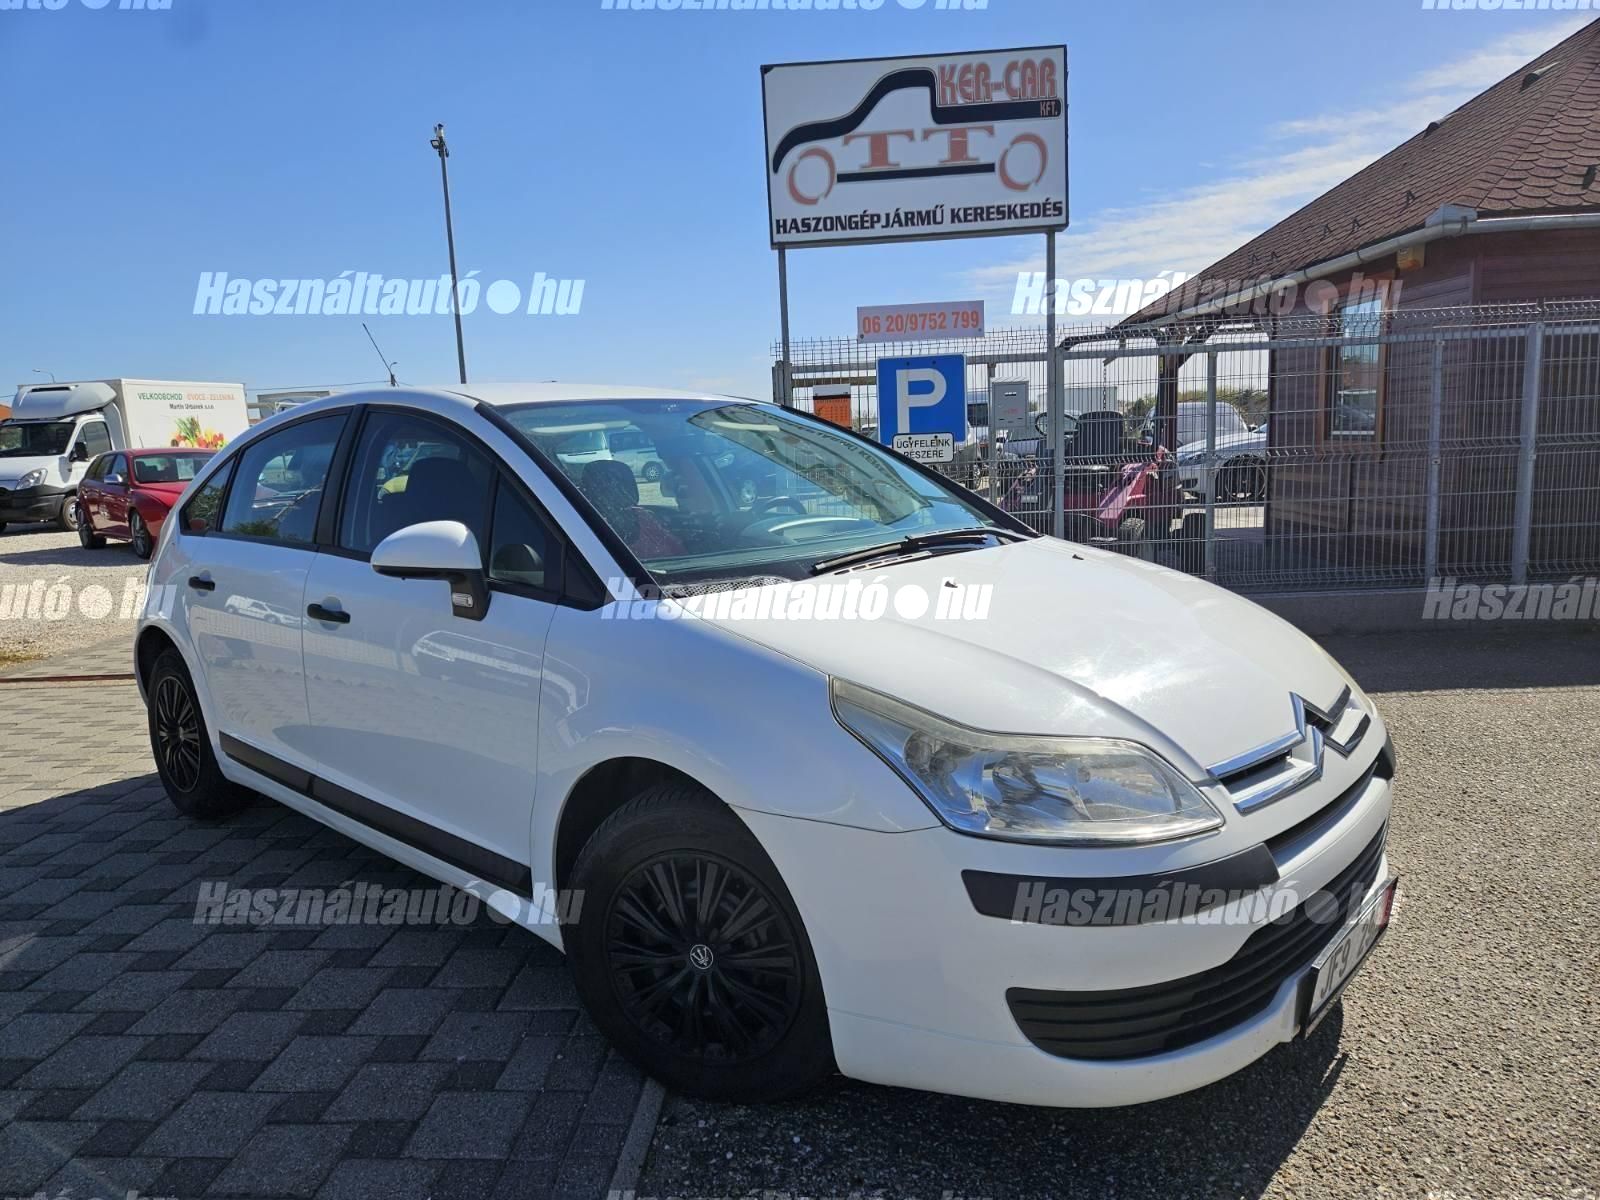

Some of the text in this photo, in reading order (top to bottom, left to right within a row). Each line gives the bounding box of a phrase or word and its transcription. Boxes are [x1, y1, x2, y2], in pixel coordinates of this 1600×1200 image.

[938, 58, 1057, 105] KER-CAR
[1040, 101, 1058, 117] KFT.
[776, 197, 1063, 234] HASZONGÉPJÁRMŰ KERESKEDÉS
[862, 310, 979, 334] 06 20/9752 799
[896, 368, 947, 434] P
